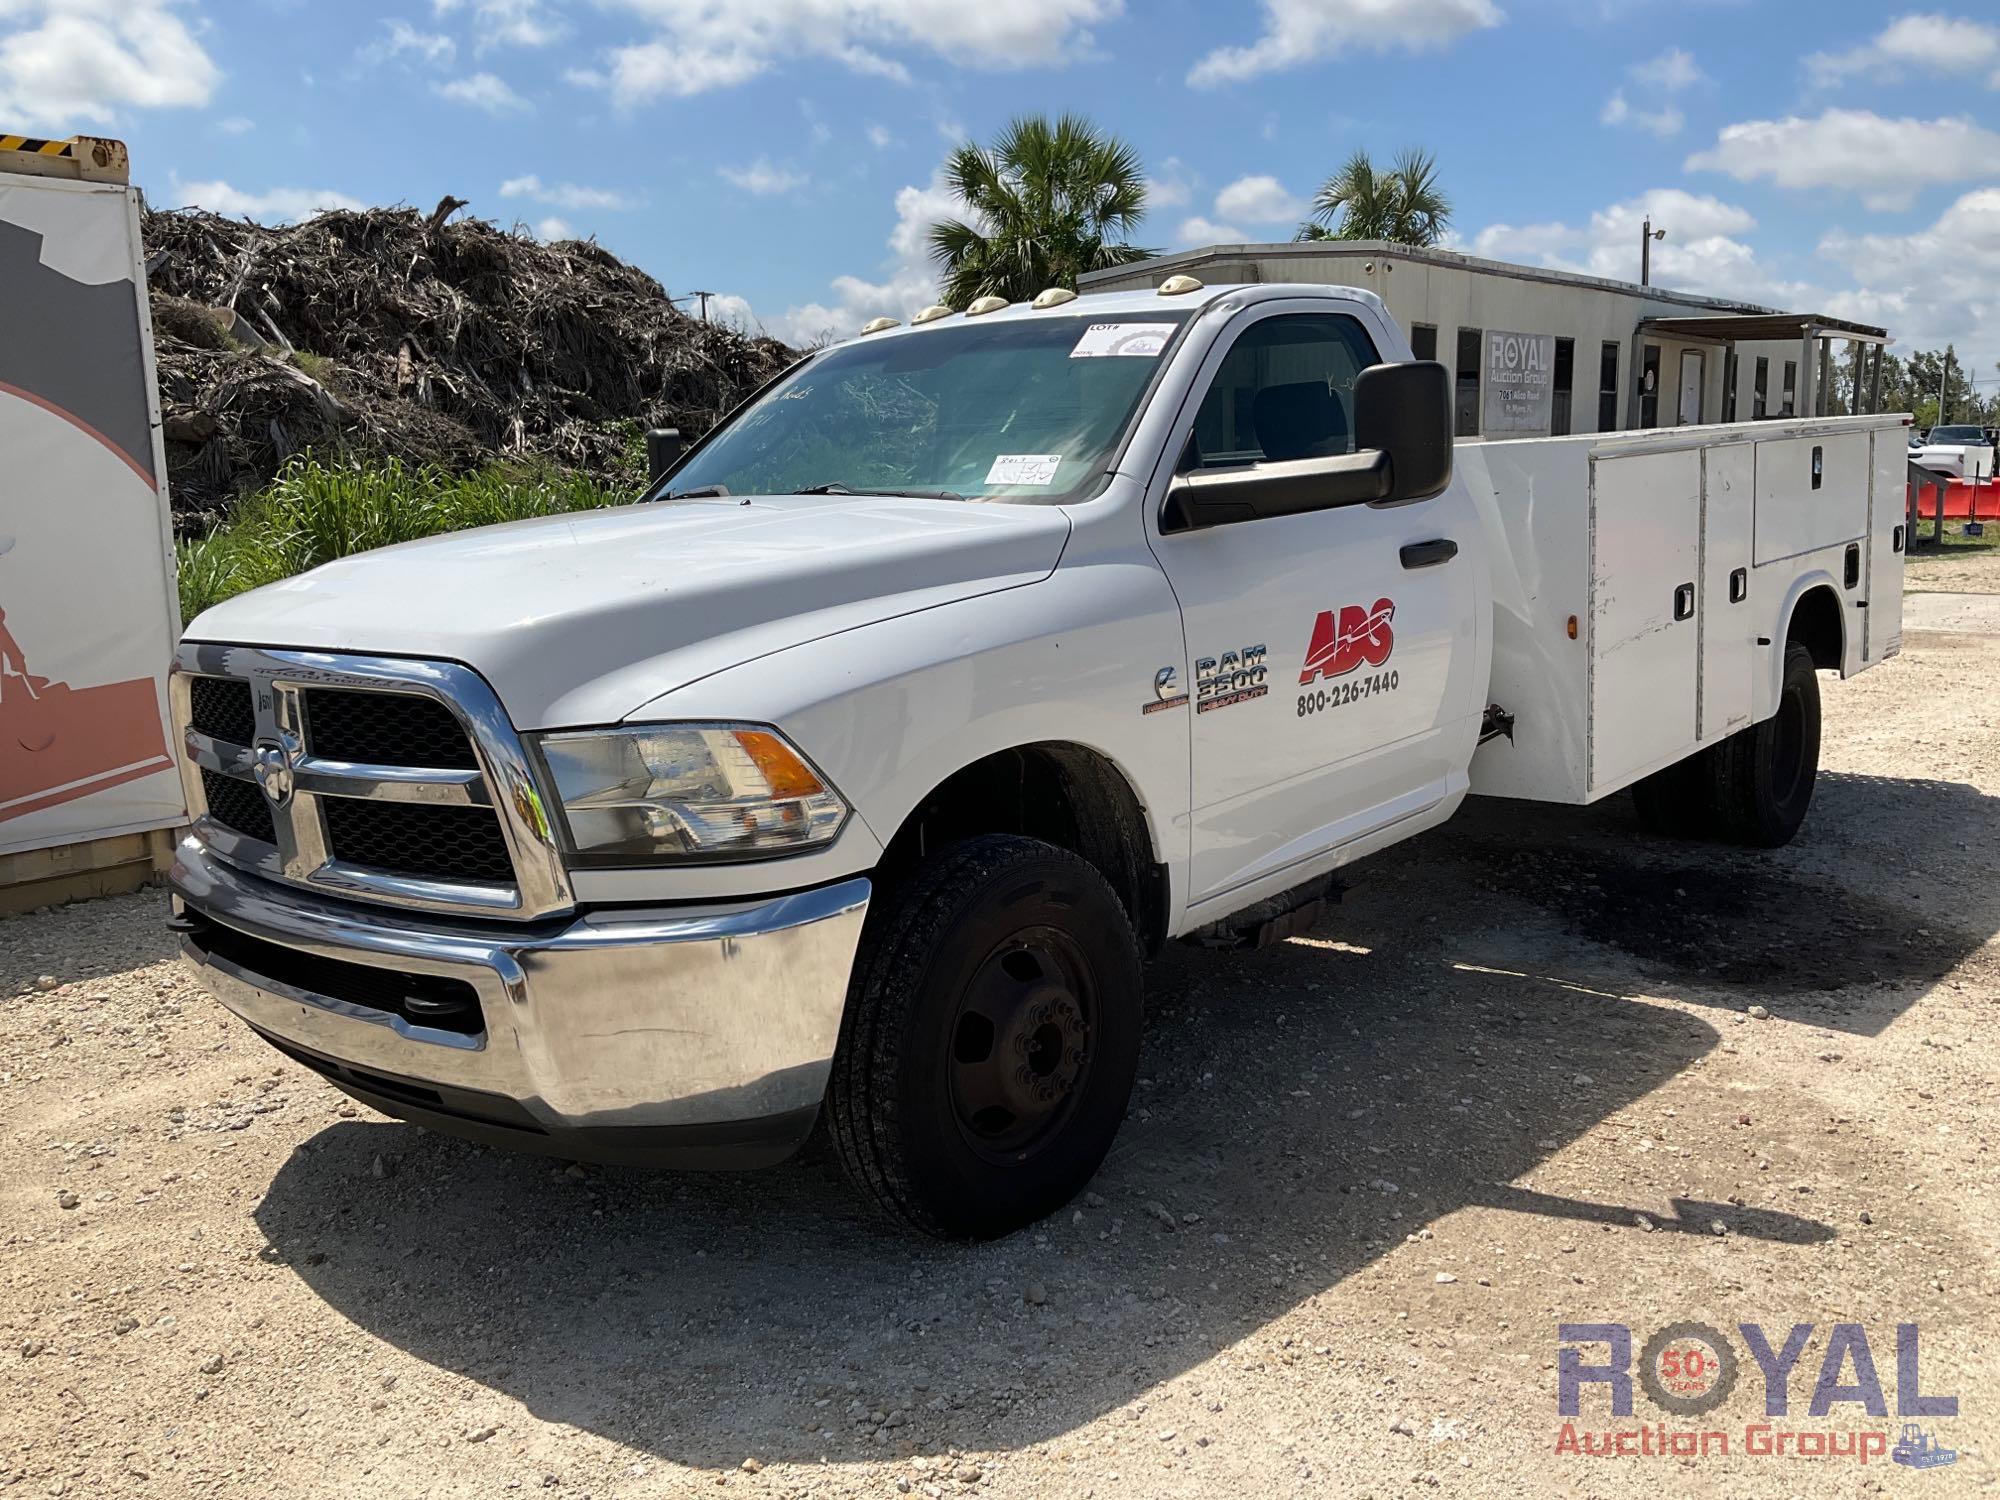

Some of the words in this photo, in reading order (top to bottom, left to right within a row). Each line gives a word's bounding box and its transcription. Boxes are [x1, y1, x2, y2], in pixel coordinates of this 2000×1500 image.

[1492, 336, 1547, 371] ROYAL
[1491, 369, 1523, 384] Auction
[1525, 371, 1547, 387] Group
[1499, 390, 1513, 400] 7061
[1299, 598, 1395, 686] ADS
[1196, 644, 1267, 680] RAM
[1197, 665, 1268, 700] 3500
[1201, 694, 1238, 712] HEAVY
[1239, 687, 1266, 702] DUTY
[1297, 670, 1399, 717] 800-226-7440
